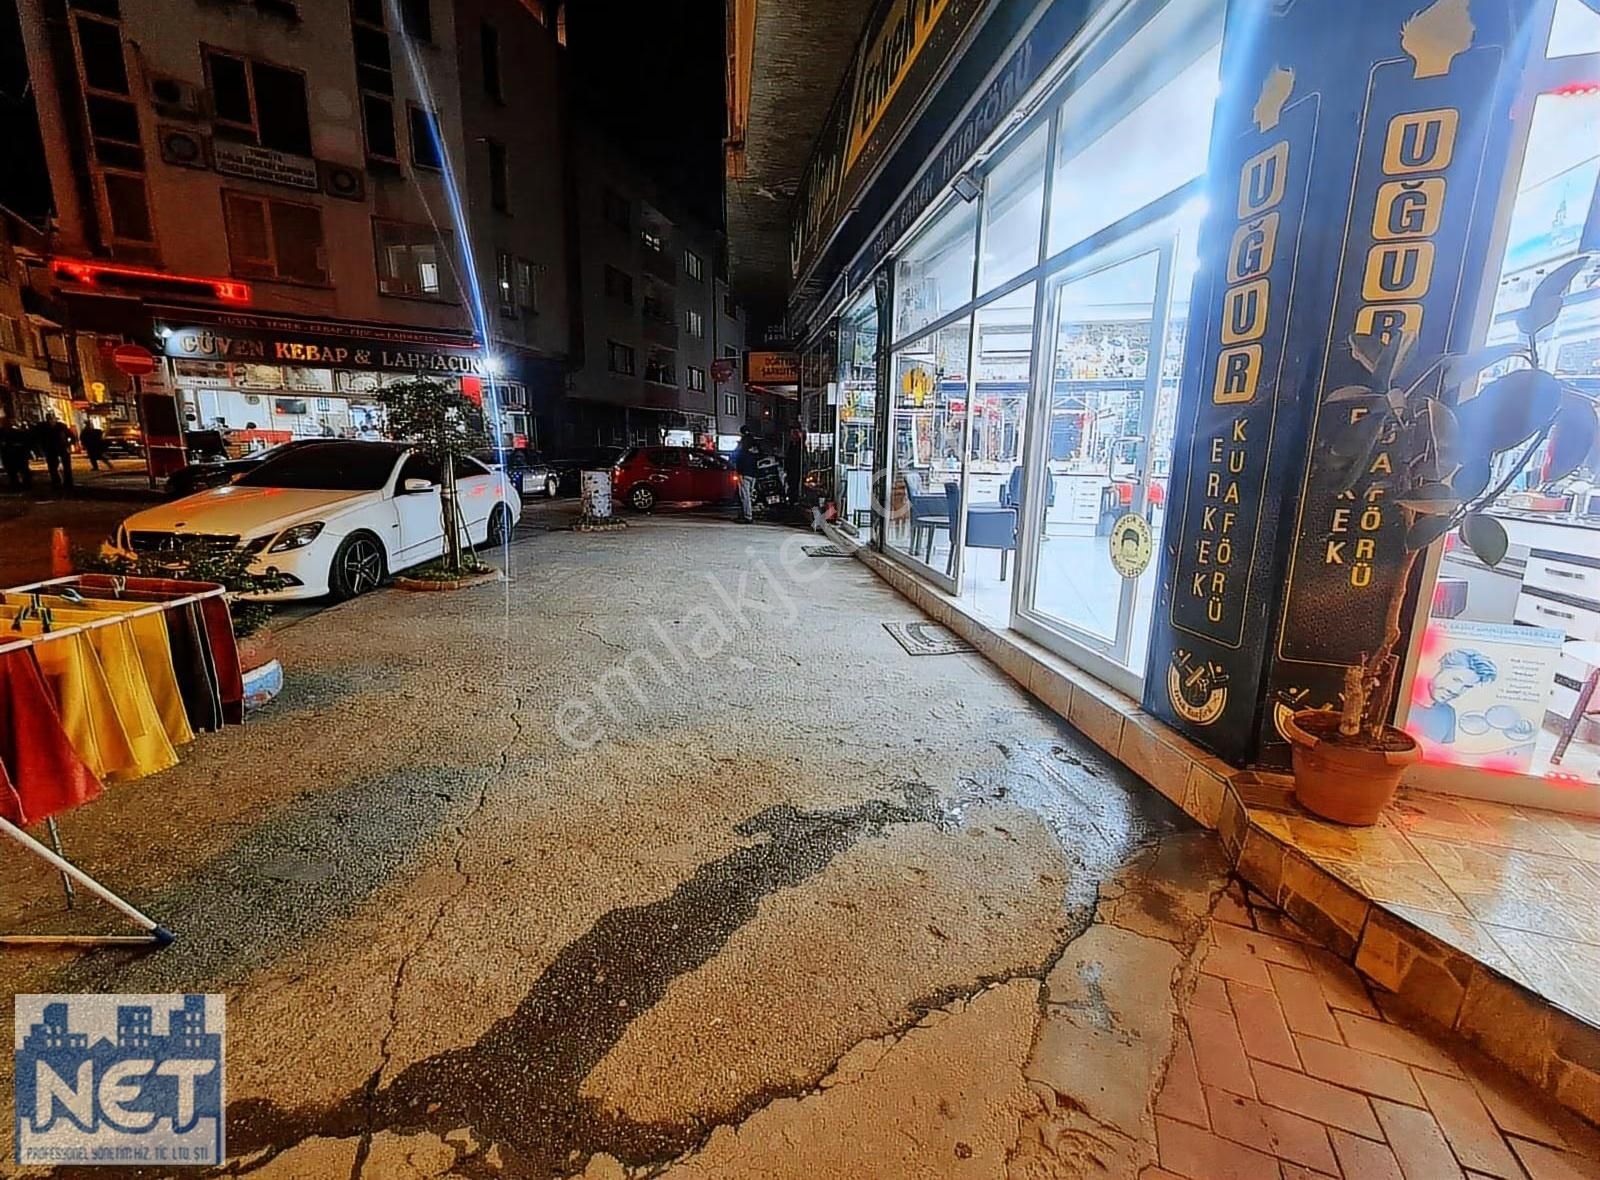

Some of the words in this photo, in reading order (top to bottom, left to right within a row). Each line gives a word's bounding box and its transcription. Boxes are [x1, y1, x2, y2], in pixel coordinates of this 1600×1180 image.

[181, 331, 264, 358] GÜVEN
[275, 342, 348, 363] KEBAP
[354, 349, 371, 365] &
[1219, 148, 1283, 399] UĞUR
[1192, 438, 1224, 597] ERKEK
[1208, 419, 1248, 622] KUAFÖRÜ
